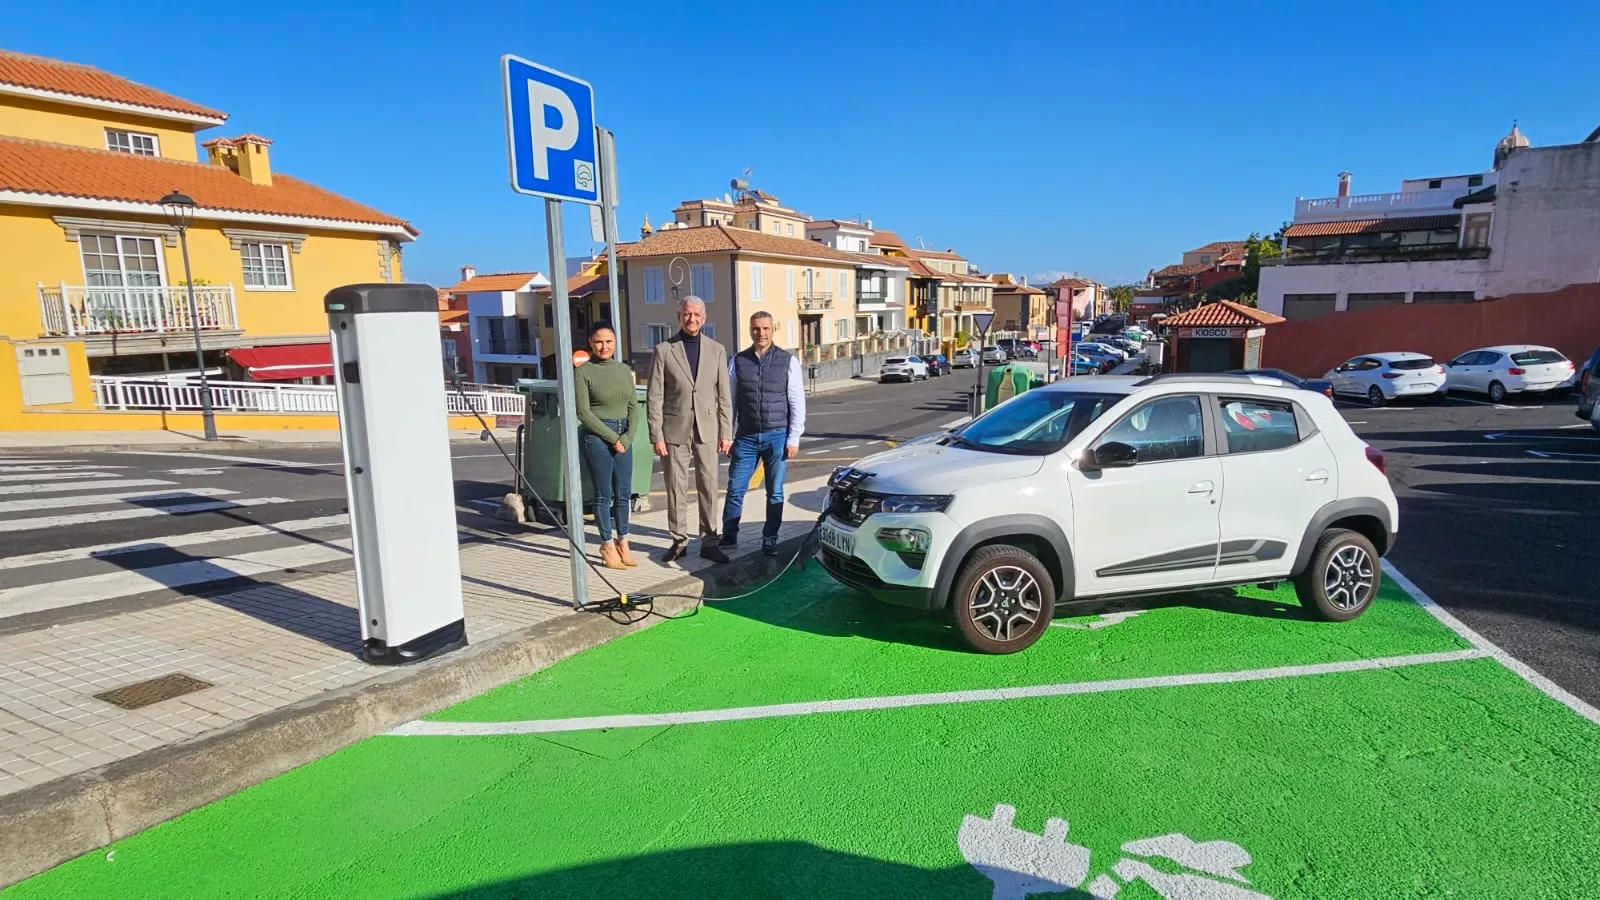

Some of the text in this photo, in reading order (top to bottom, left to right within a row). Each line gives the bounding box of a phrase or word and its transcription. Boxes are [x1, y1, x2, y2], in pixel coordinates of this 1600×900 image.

[527, 78, 579, 181] P
[1195, 328, 1227, 337] KIOSCO
[837, 533, 850, 553] LYN
